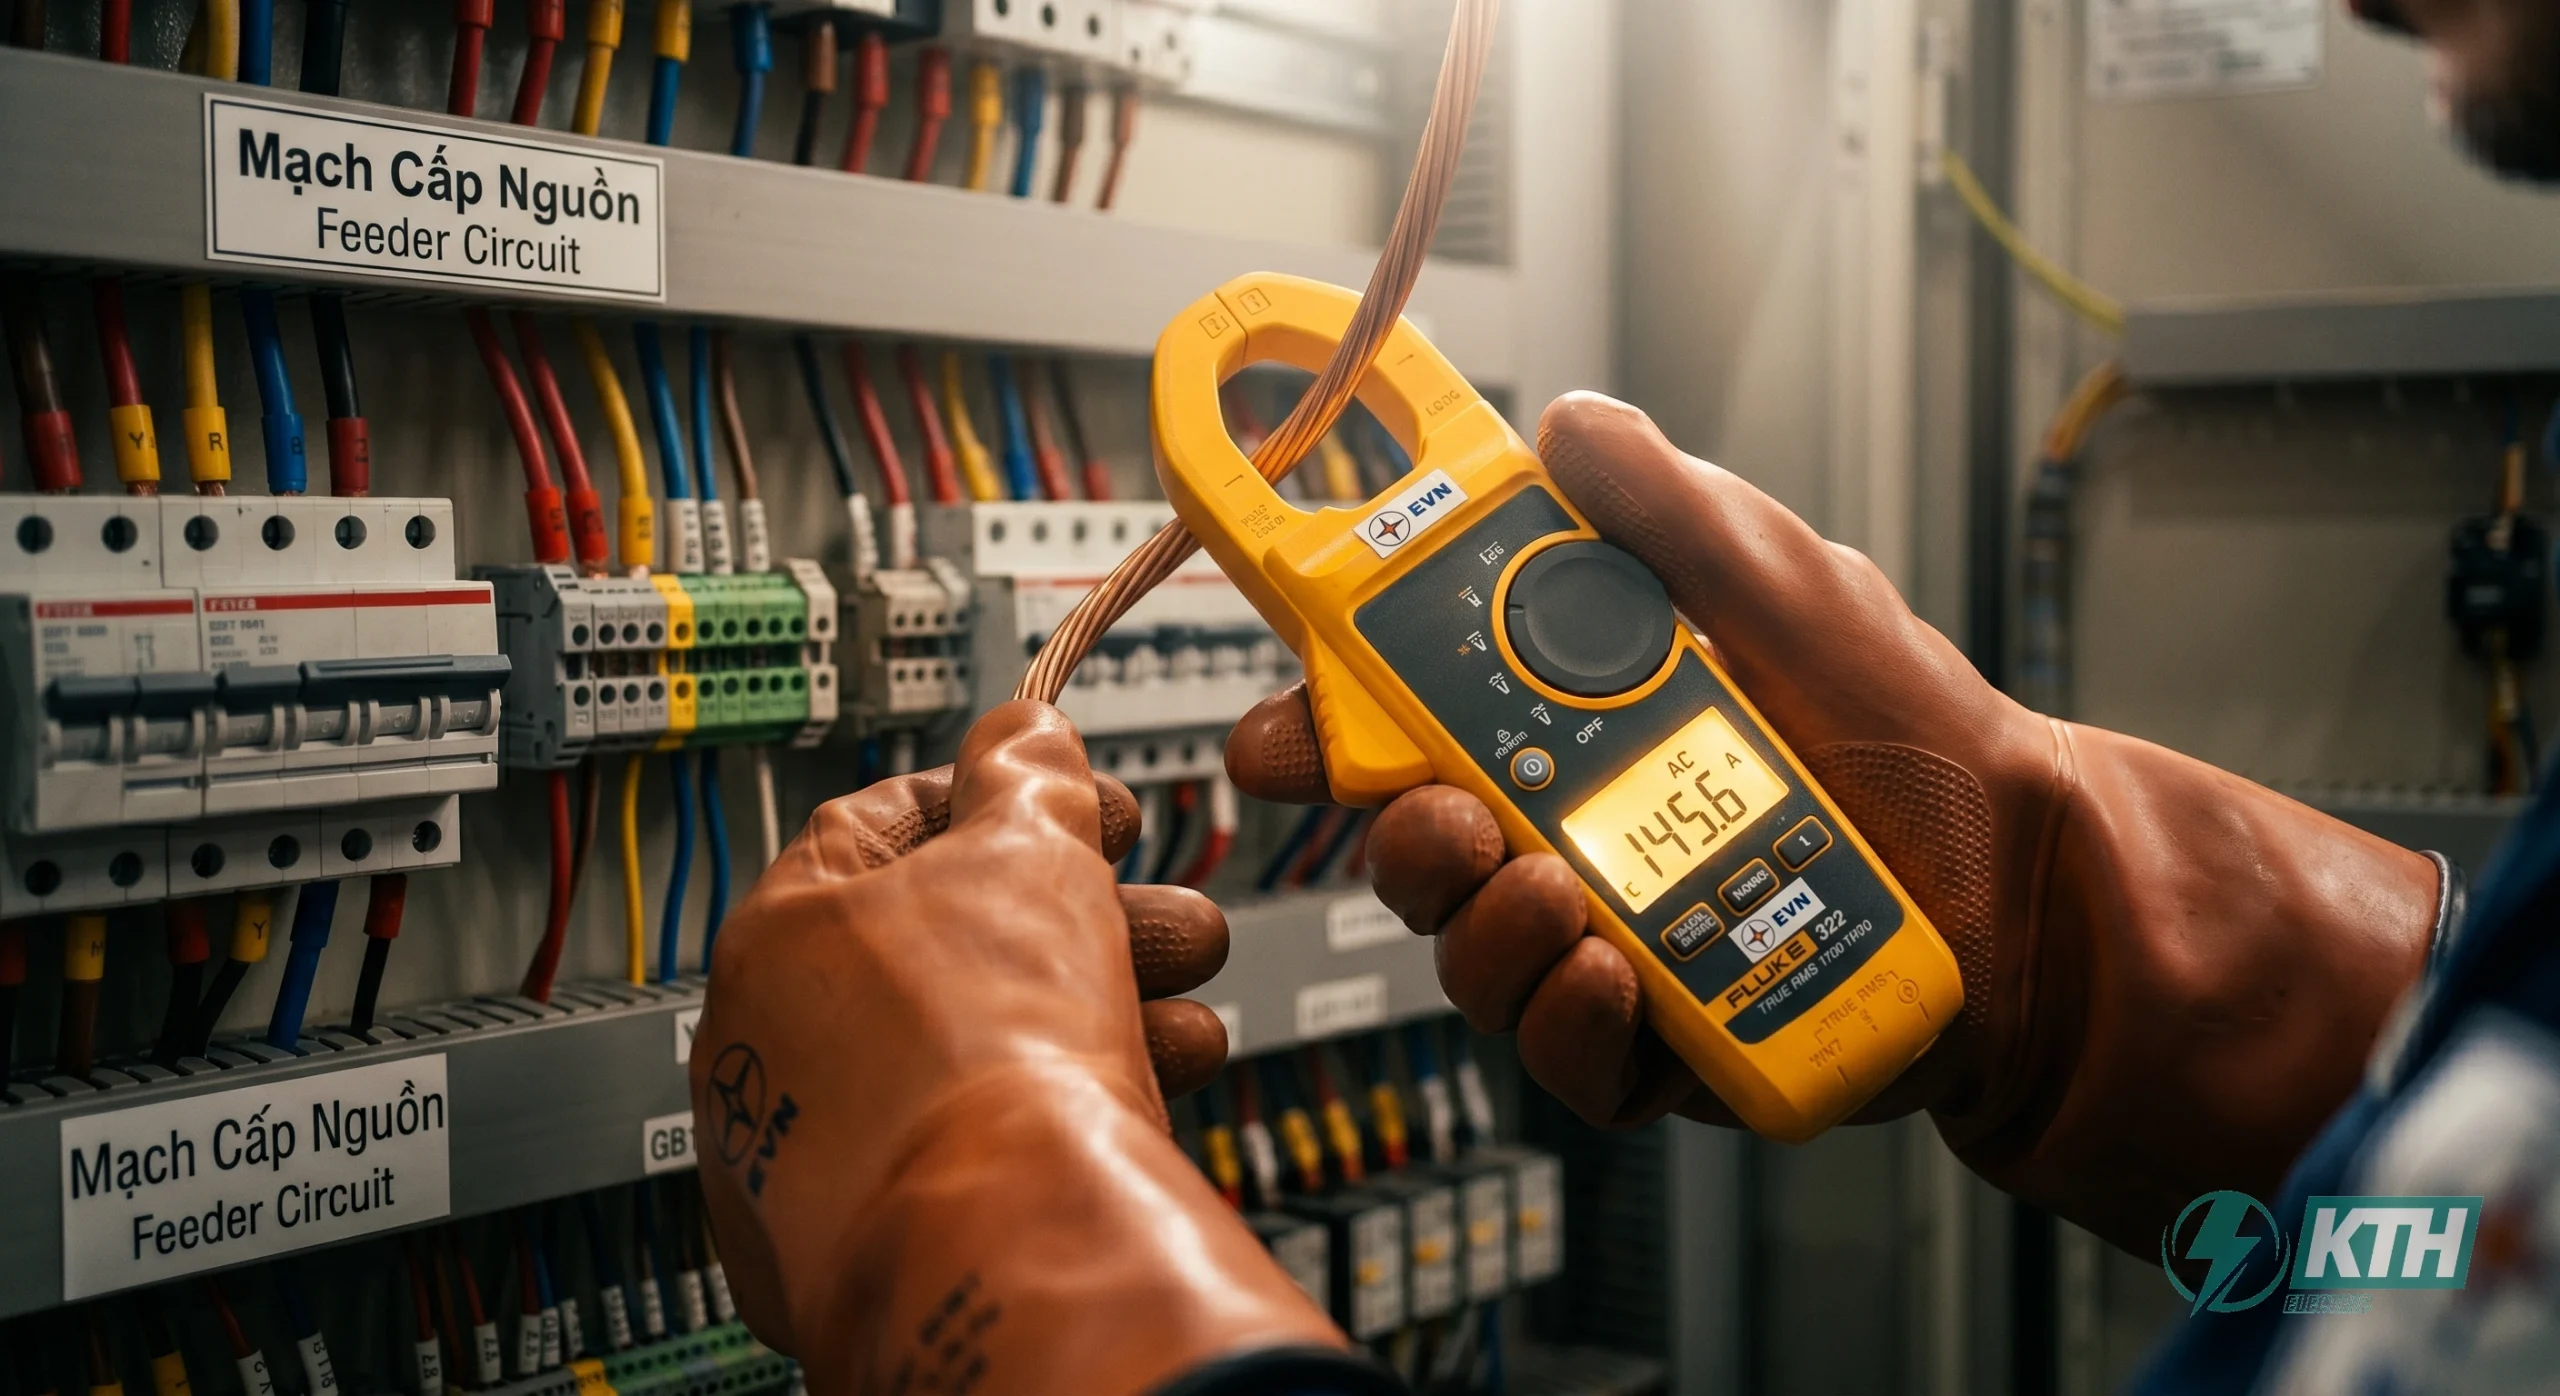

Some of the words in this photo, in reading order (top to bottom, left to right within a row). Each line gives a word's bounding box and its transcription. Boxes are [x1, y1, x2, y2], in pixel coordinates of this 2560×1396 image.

[239, 128, 373, 196] Mạch
[390, 144, 483, 215] Cấp
[499, 164, 640, 226] Nguồn
[317, 206, 450, 261] Feeder
[463, 224, 581, 275] Circuit
[208, 433, 224, 451] R
[1407, 482, 1453, 517] EVN
[1576, 717, 1604, 744] OFF
[1667, 750, 1695, 779] AC
[1725, 752, 1742, 769] A
[1624, 769, 1747, 878] 145.6
[253, 920, 267, 939] Y
[1771, 892, 1811, 927] EVN
[1726, 940, 1807, 1009] FLUKE
[1815, 910, 1847, 941] 322
[1757, 984, 1792, 1015] TRUE
[1790, 962, 1819, 990] RMS
[1820, 998, 1858, 1030] TRUE
[1856, 973, 1888, 1002] RMS
[71, 1129, 196, 1200] Mạch
[212, 1103, 296, 1172] Cấp
[312, 1079, 444, 1156] Nguồn
[651, 1125, 697, 1162] GB
[133, 1200, 264, 1260] Feeder
[277, 1167, 395, 1229] Circuit
